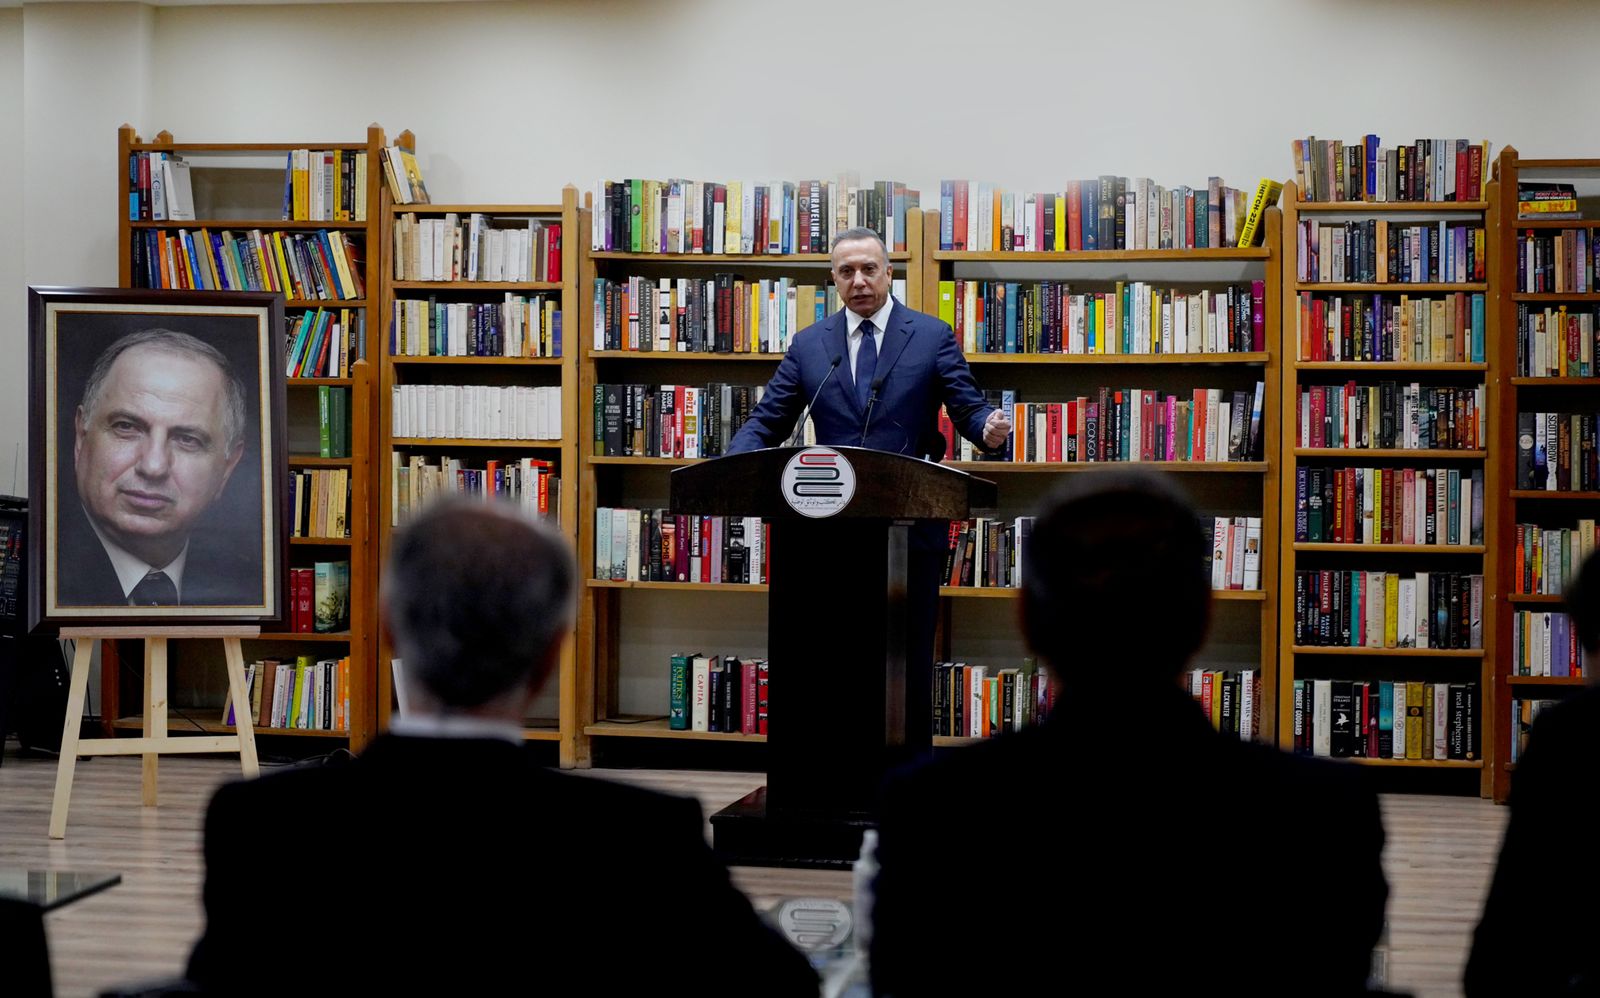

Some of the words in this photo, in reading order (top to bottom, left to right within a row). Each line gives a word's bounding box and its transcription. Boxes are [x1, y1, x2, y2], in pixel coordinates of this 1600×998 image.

[811, 187, 820, 237] UNRAVELING
[1088, 422, 1096, 456] CONGO
[1548, 415, 1557, 436] SCOTT
[1548, 436, 1557, 463] TUROW
[1295, 690, 1303, 709] ROBERT
[1455, 692, 1463, 709] neal
[1294, 709, 1302, 736] GODDARD
[1453, 711, 1463, 754] stephenson
